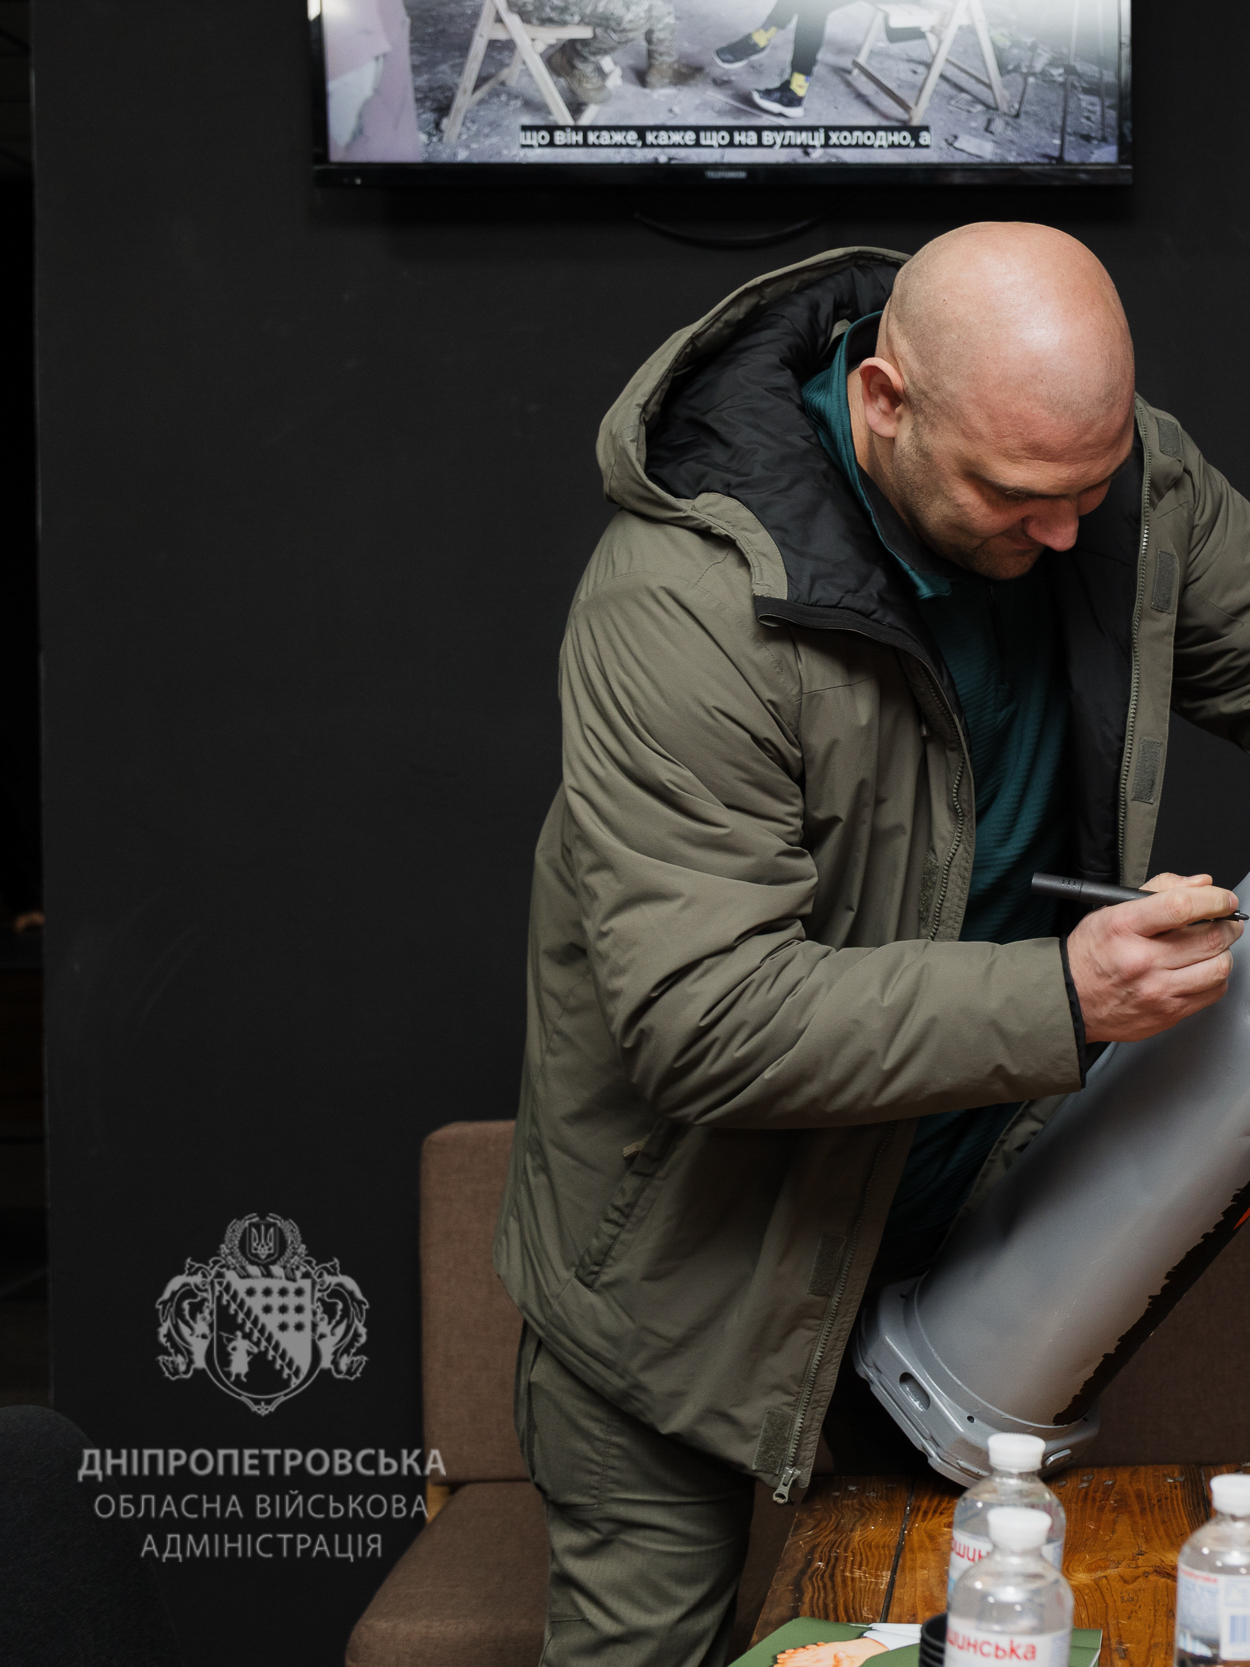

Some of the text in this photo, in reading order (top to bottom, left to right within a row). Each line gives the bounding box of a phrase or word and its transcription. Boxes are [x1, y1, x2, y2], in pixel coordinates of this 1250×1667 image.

[520, 127, 932, 149] що він каже, каже що на вулиці холодно, а
